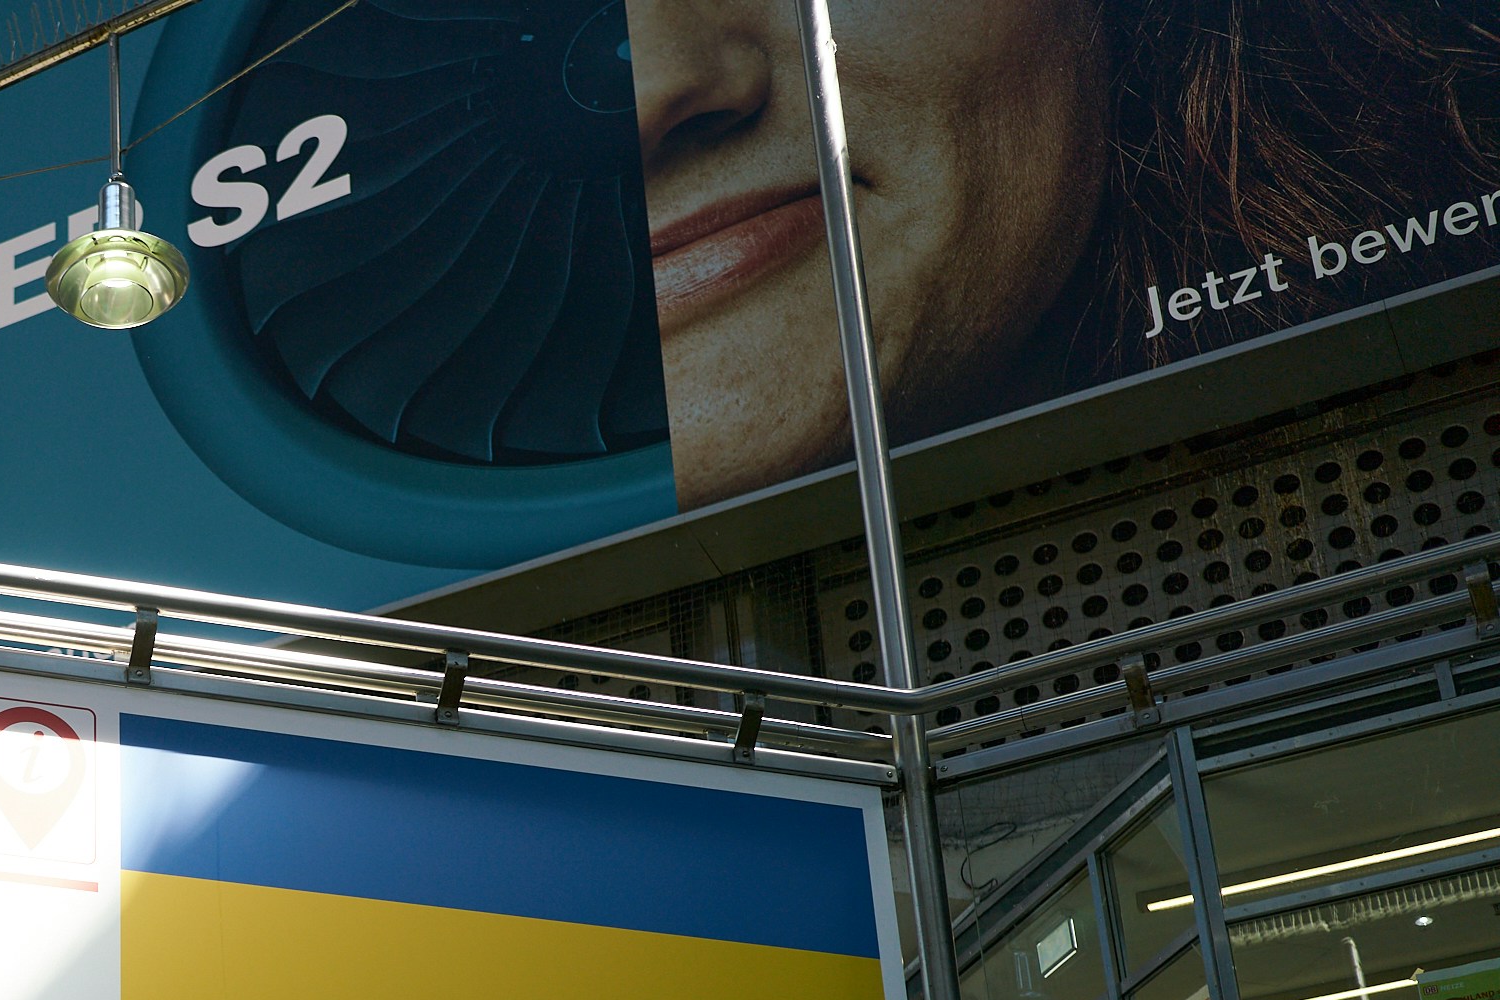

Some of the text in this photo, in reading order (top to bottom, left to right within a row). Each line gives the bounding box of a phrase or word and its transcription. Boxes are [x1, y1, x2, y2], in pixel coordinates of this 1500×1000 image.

[187, 114, 351, 247] S2
[1146, 189, 1500, 338] Jetzt bewer
